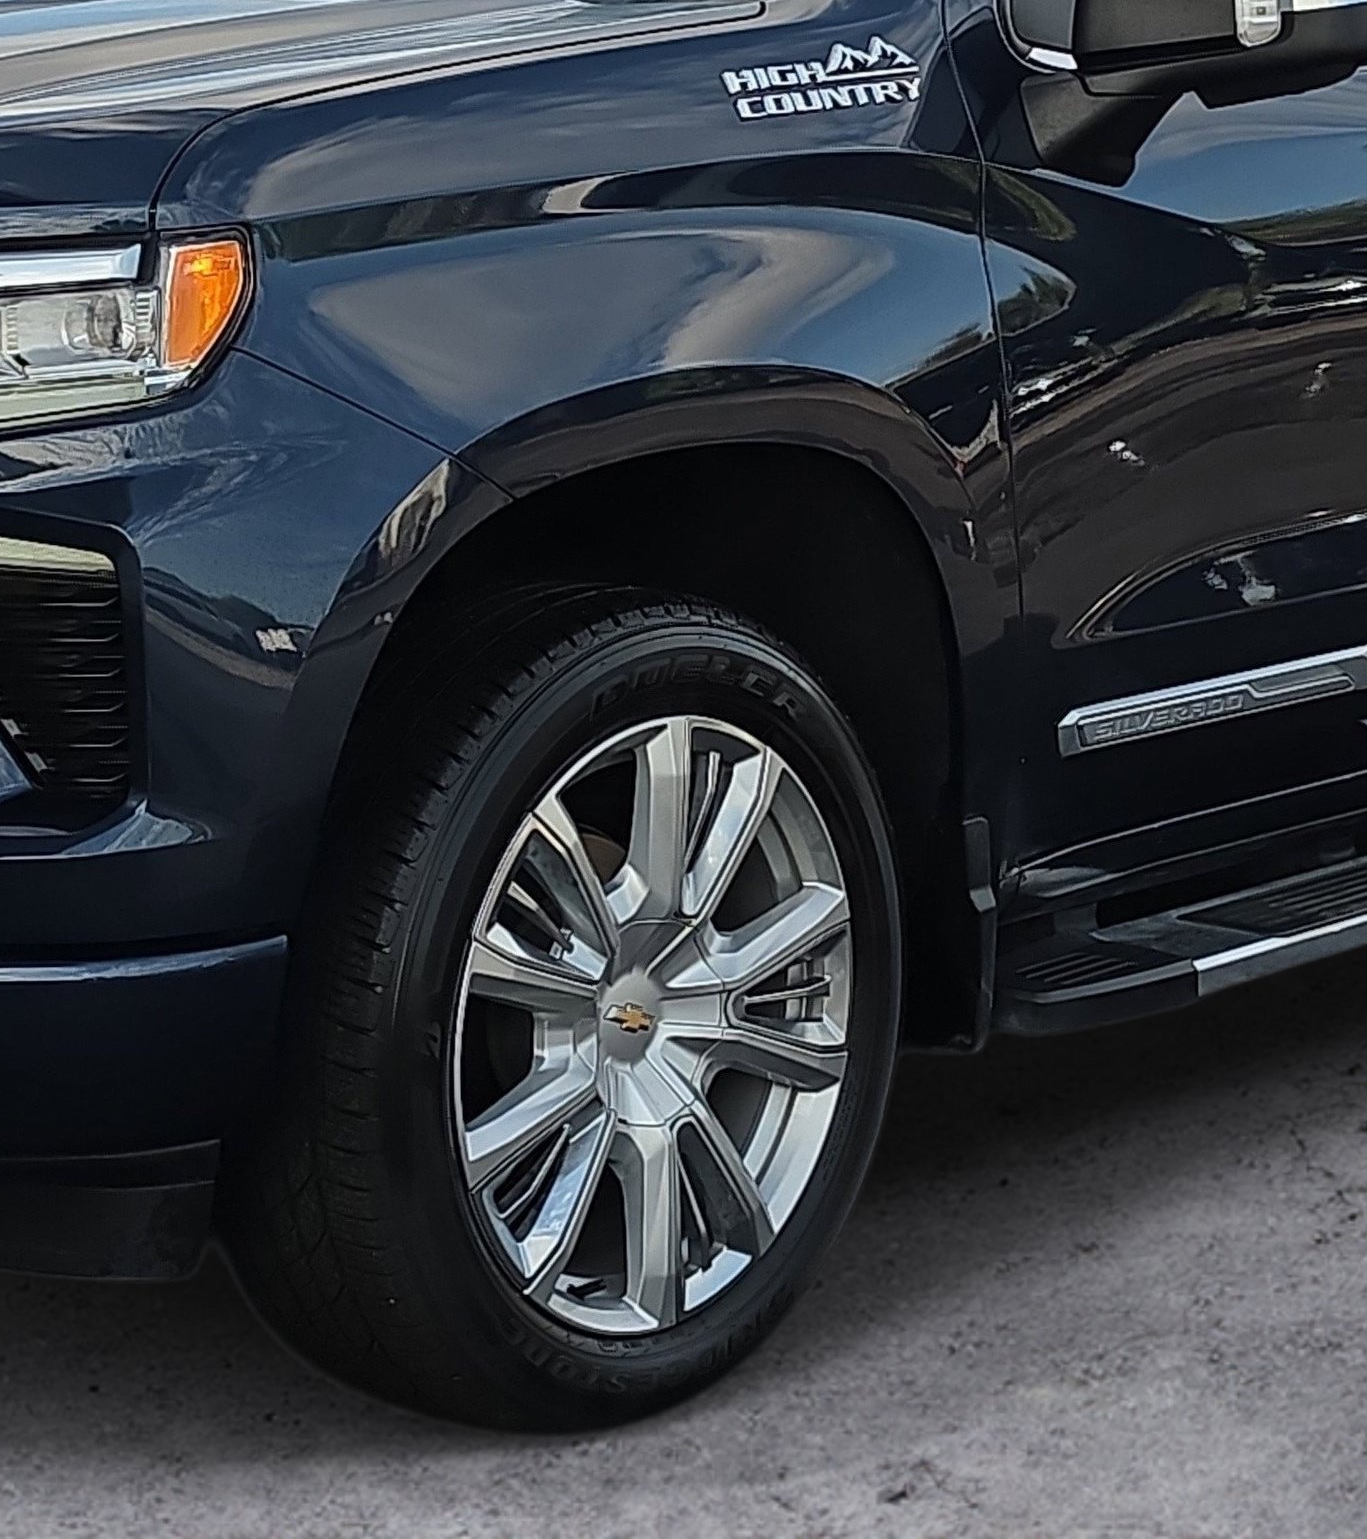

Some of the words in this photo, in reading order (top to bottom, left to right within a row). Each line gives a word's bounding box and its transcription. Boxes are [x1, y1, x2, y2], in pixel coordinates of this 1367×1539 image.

[722, 61, 827, 95] HIGH
[736, 77, 921, 119] COUNTRY
[1094, 694, 1244, 741] SILVERADO
